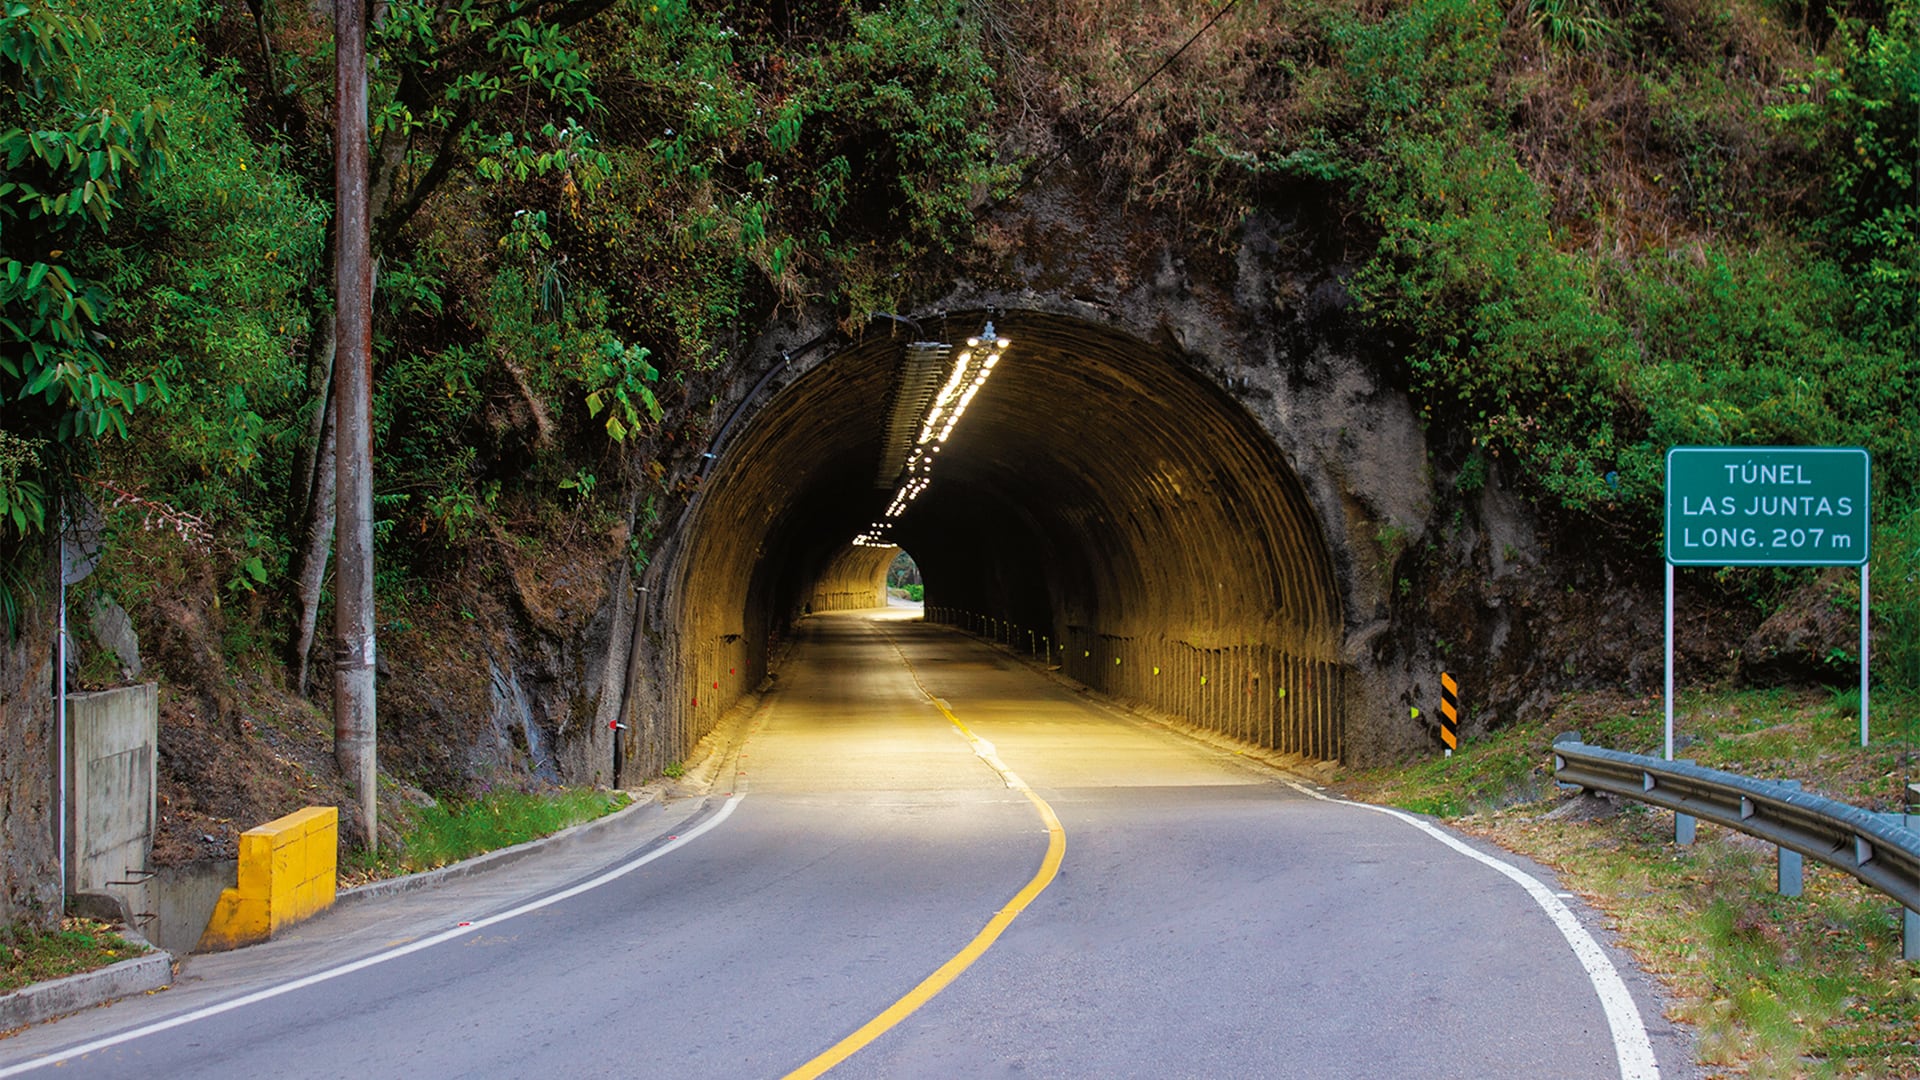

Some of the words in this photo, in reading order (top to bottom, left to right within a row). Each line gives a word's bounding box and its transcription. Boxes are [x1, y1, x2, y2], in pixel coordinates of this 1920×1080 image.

[1724, 460, 1812, 484] TÚNEL
[1683, 496, 1736, 516] LAS
[1744, 496, 1853, 516] JUNTAS
[1684, 527, 1764, 547] LONG.
[1772, 528, 1825, 548] 207
[1831, 533, 1851, 548] m
